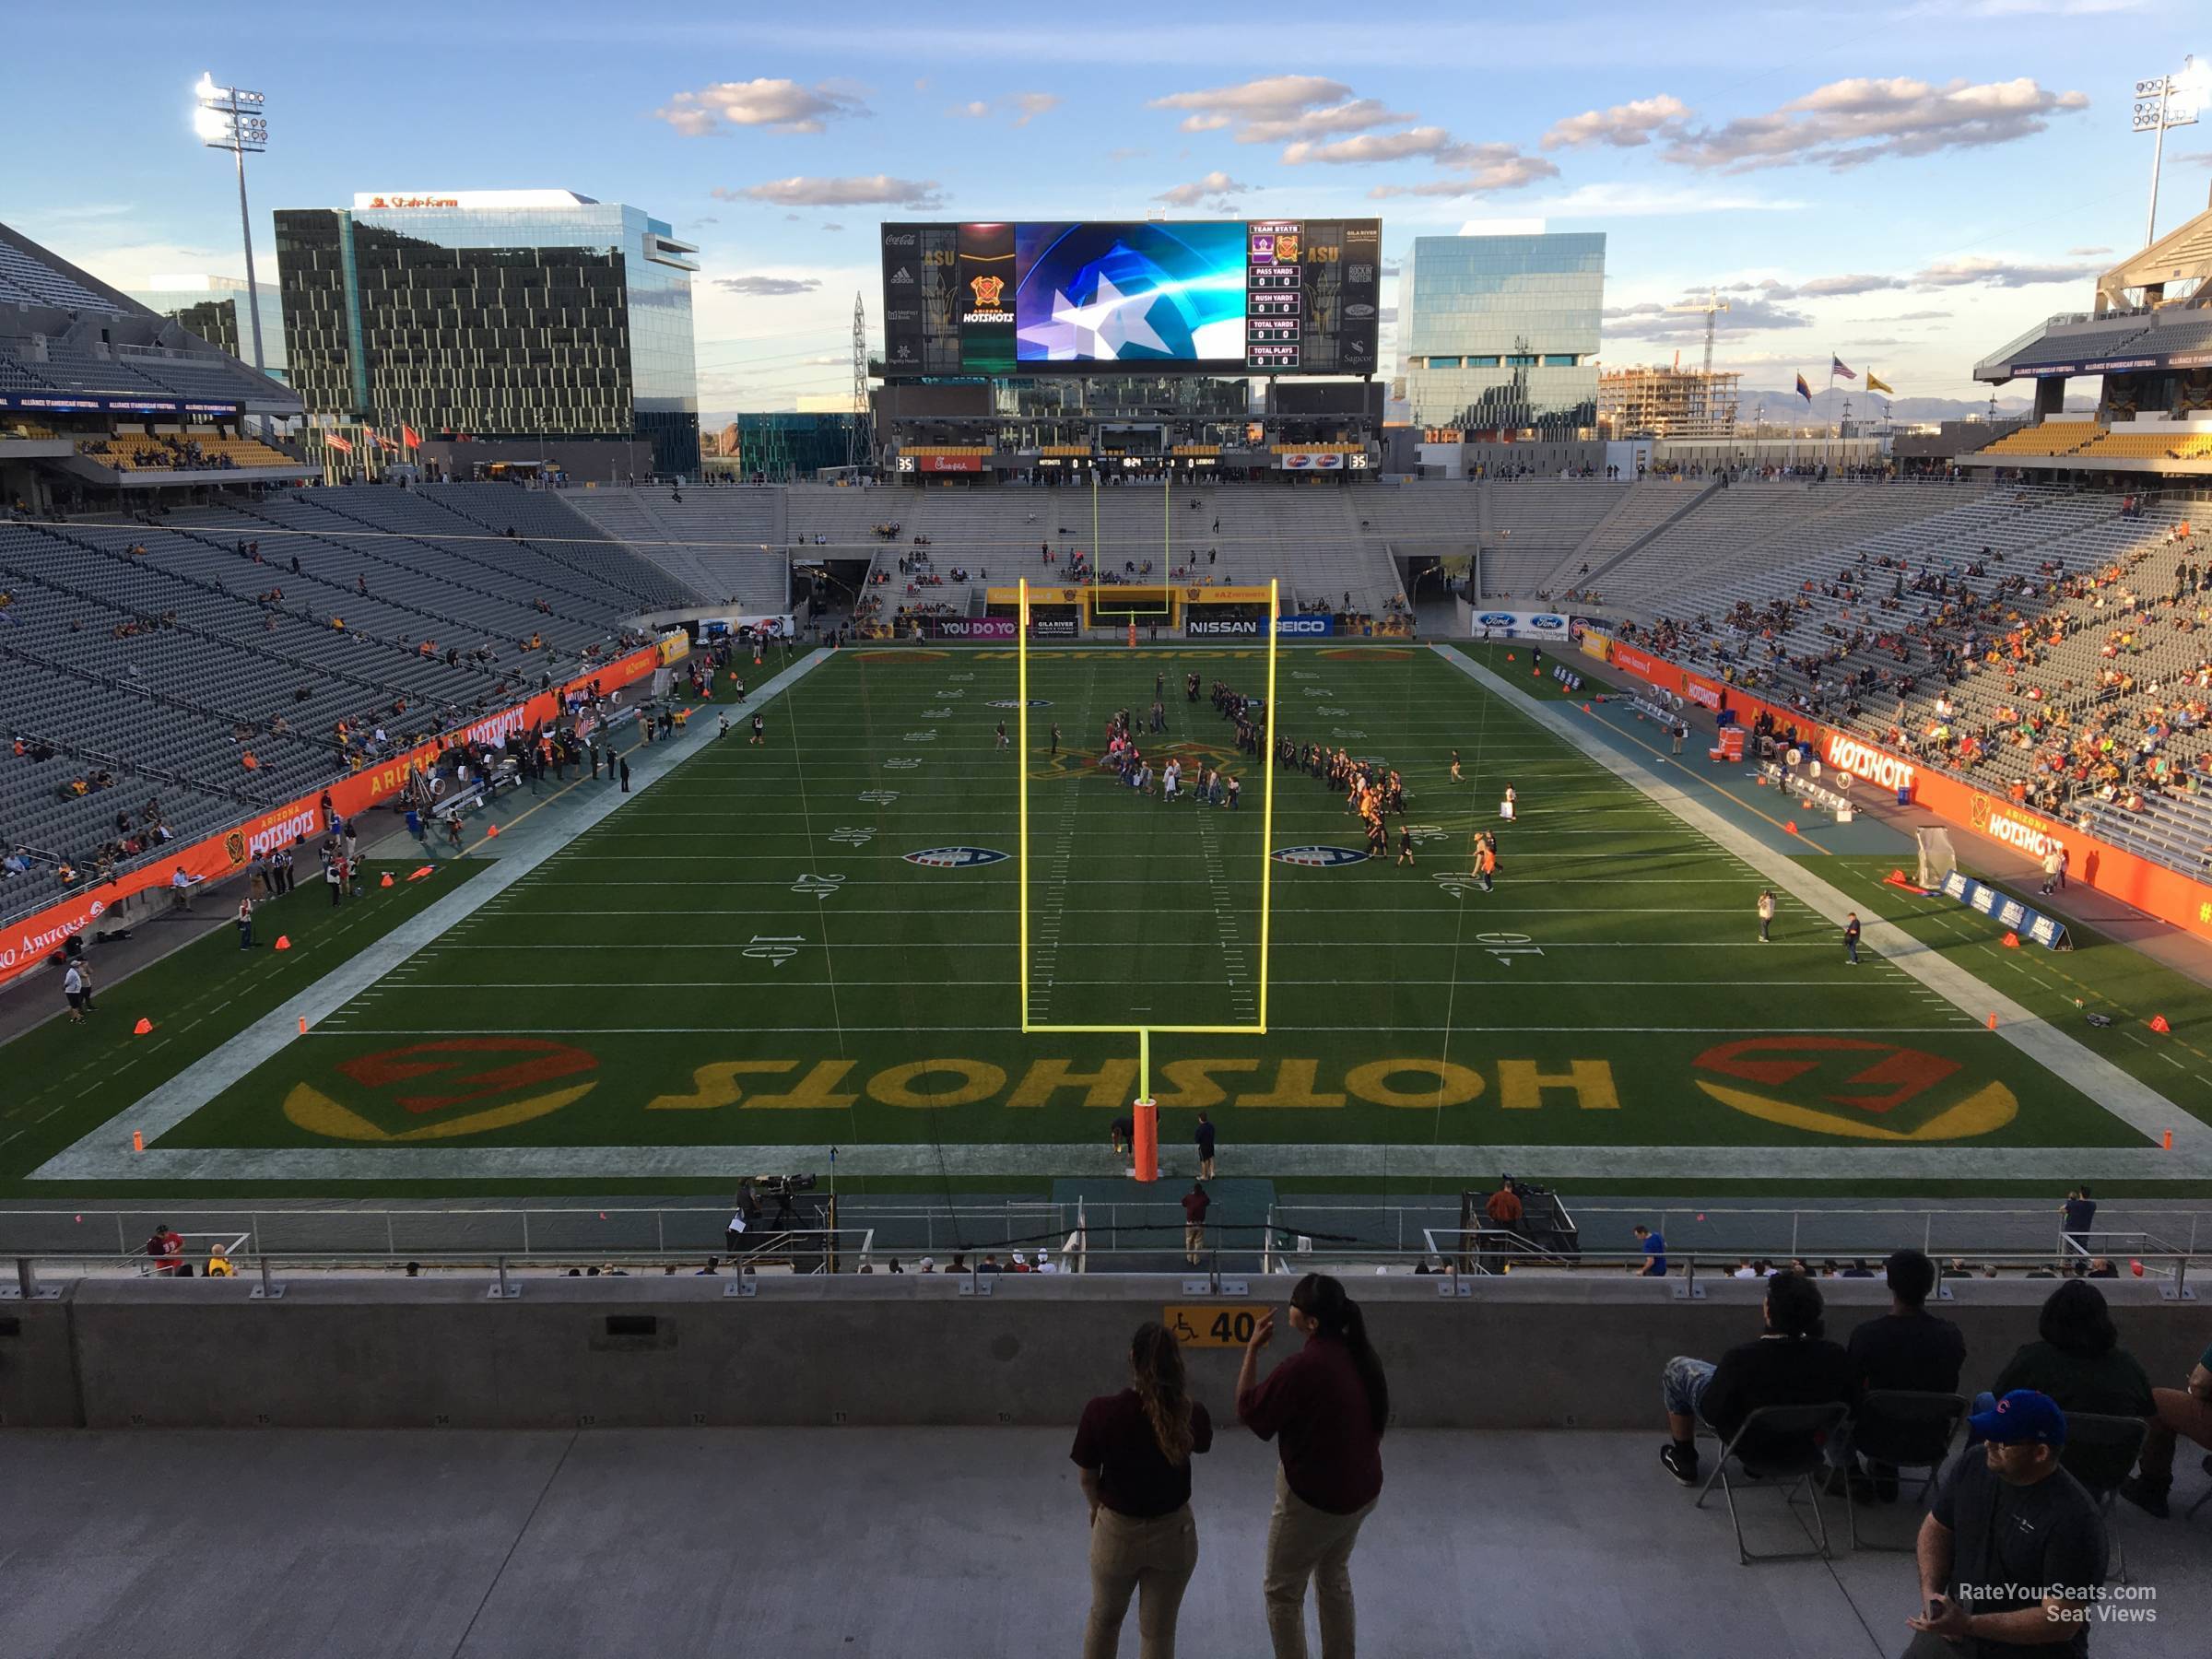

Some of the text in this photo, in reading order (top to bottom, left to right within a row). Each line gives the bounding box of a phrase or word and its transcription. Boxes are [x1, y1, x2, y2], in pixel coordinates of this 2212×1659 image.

[392, 196, 458, 207] State Farm
[924, 251, 955, 265] ASU
[1307, 247, 1338, 263] ASU
[1259, 277, 1265, 286] 0
[1284, 277, 1289, 286] 0
[1258, 304, 1265, 312] 0
[1283, 304, 1289, 312] 0
[963, 313, 1014, 323] HOTSHOTS
[1344, 355, 1372, 365] Sagicor
[899, 458, 912, 470] 35
[1073, 459, 1078, 468] 0
[1124, 457, 1141, 467] 18:24
[1188, 459, 1194, 468] 0
[1352, 455, 1366, 467] 35
[1272, 620, 1324, 632] GEICO
[1486, 616, 1510, 625] Ford
[1537, 618, 1559, 627] Ford
[941, 622, 970, 634] YOU
[973, 622, 994, 634] DO
[1191, 622, 1256, 633] NISSAN
[1829, 735, 1913, 790] HOTSHOTS
[261, 806, 300, 828] ARIZONA
[2005, 808, 2048, 832] ARIZONA
[249, 809, 313, 860] HOTSHOTS
[791, 873, 846, 893] 20
[742, 935, 806, 959] 10
[1476, 932, 1545, 956] 10
[646, 1057, 1619, 1109] HOTSHOTS
[1210, 1312, 1255, 1343] 40
[1996, 1399, 2011, 1414] C
[256, 1414, 270, 1424] 15
[582, 1415, 595, 1425] 13
[693, 1414, 706, 1424] 12
[835, 1412, 847, 1422] 11
[998, 1412, 1011, 1422] 10
